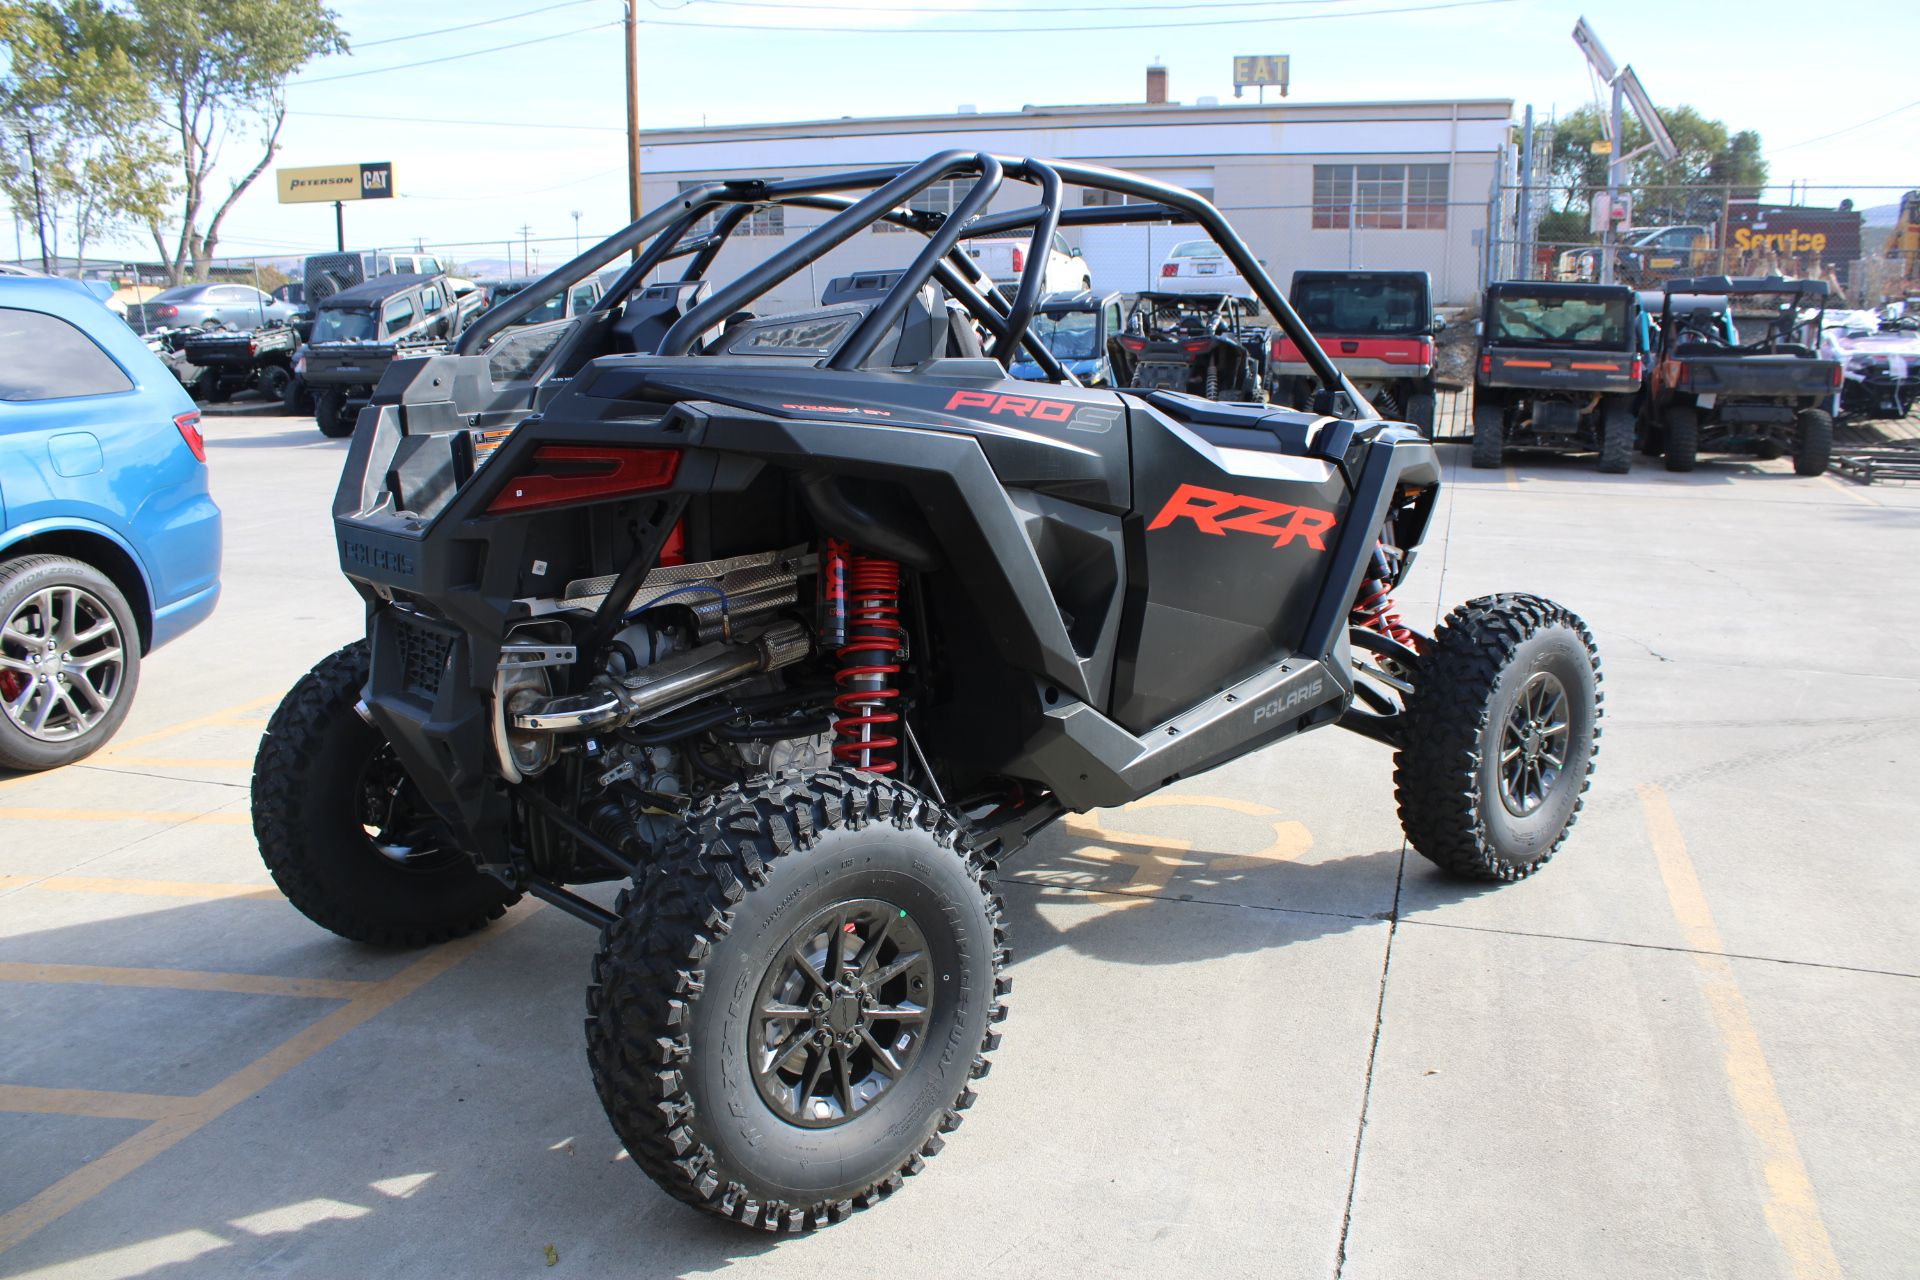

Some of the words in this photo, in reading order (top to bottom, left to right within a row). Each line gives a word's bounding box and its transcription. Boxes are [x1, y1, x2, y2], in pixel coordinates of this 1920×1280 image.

[1236, 58, 1287, 81] EAT
[290, 177, 353, 190] PETERSON
[363, 170, 388, 190] CAT
[1735, 228, 1826, 252] Service
[944, 390, 1075, 422] PRO
[1146, 483, 1337, 551] RZR
[343, 540, 415, 576] POLARIS
[1253, 678, 1323, 724] POLARIS
